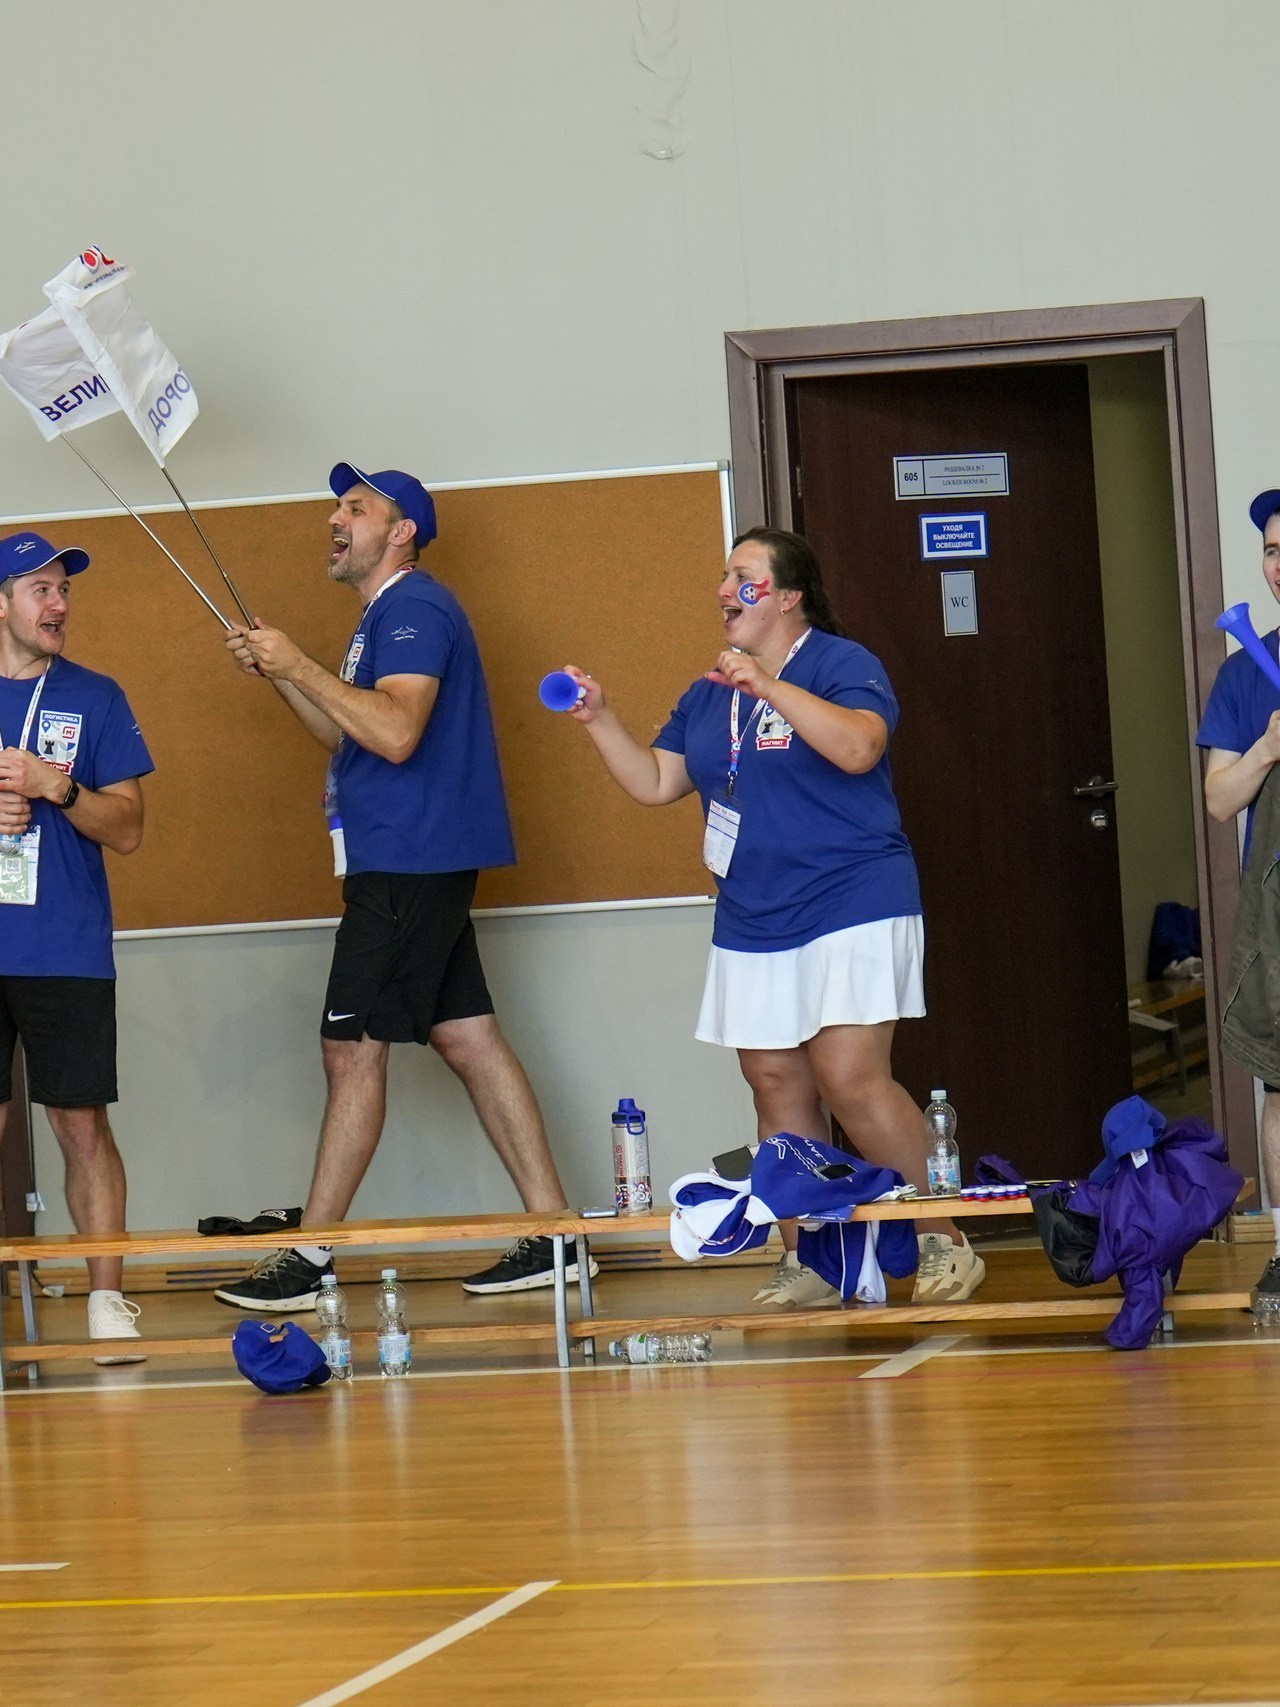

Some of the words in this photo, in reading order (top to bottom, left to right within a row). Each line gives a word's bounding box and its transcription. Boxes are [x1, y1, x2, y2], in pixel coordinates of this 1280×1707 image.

[904, 472, 918, 481] 605
[942, 524, 963, 532] УХОДЯ
[933, 532, 975, 541] ВЫКЛЮЧАЙТЕ
[935, 541, 974, 549] ОСВЕЩЕНИЕ
[950, 596, 969, 608] WC
[44, 713, 79, 723] ЛОГИСТИКА
